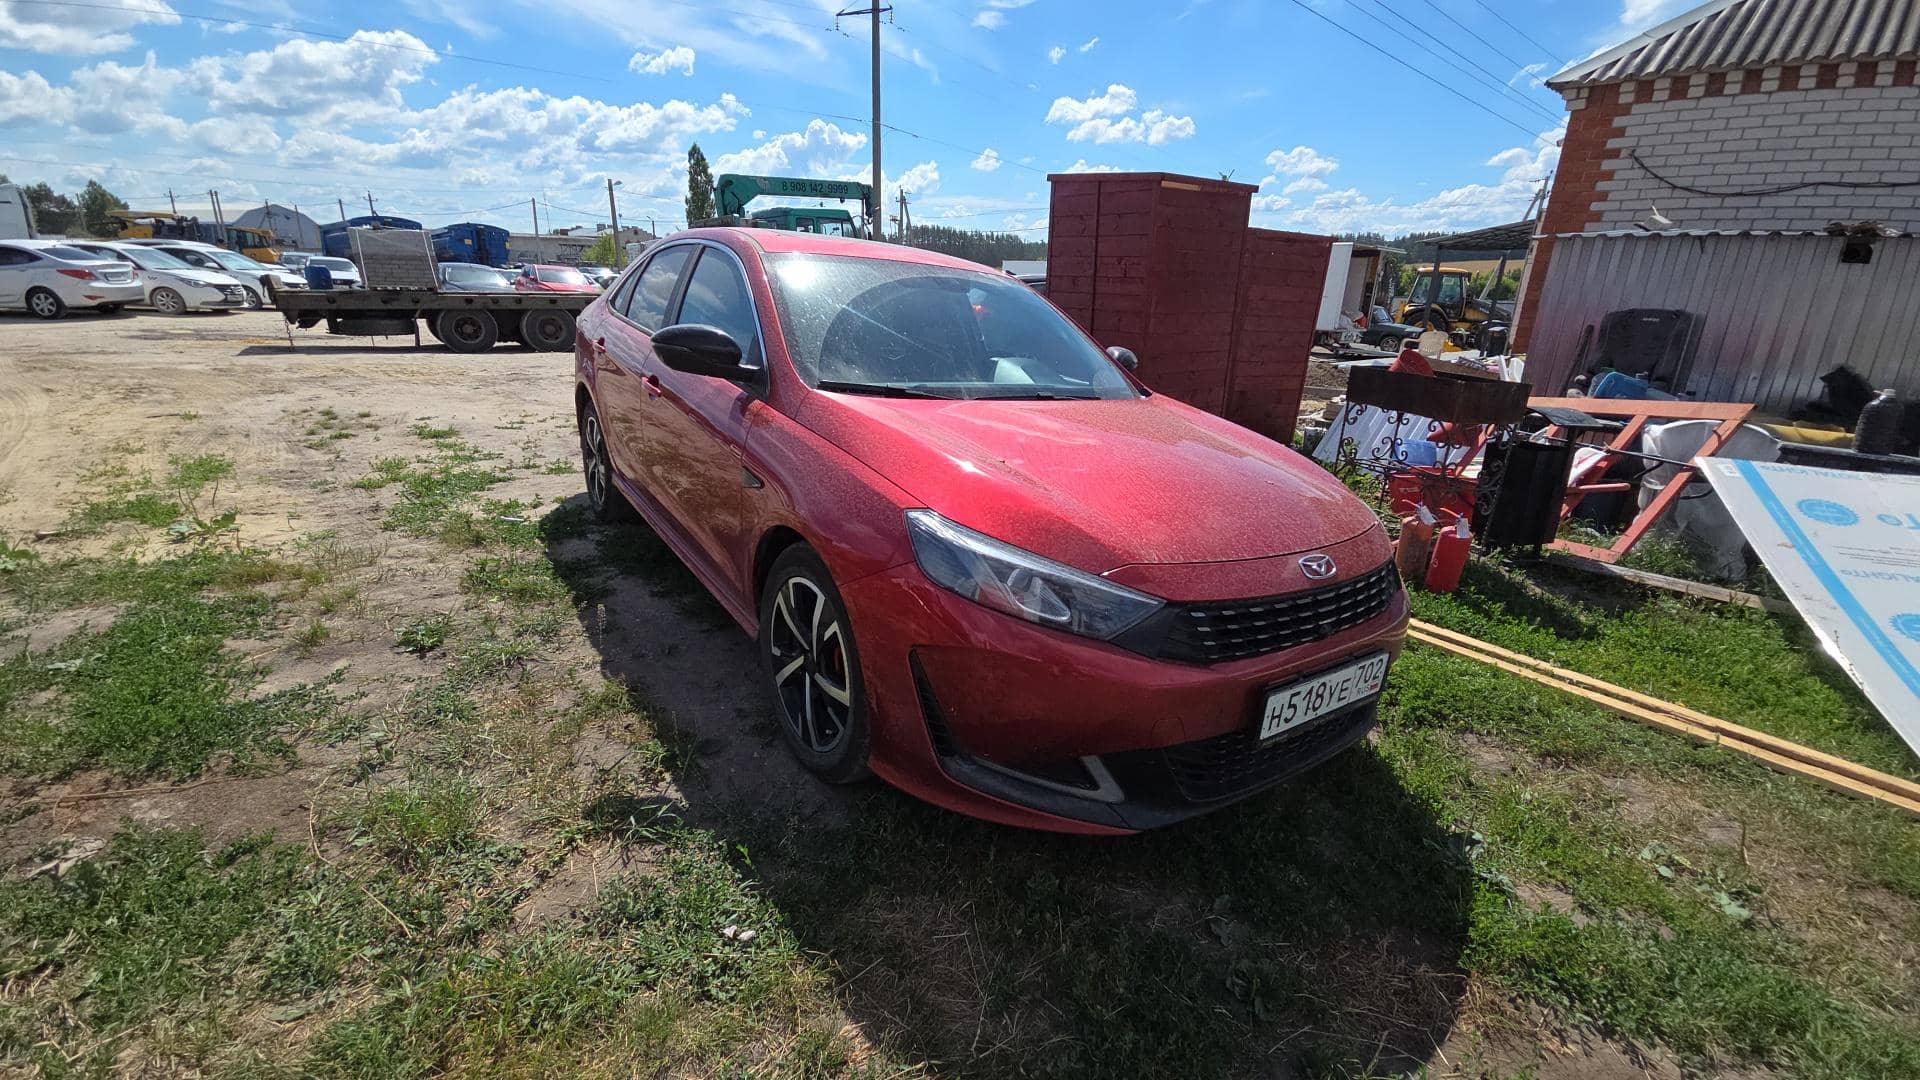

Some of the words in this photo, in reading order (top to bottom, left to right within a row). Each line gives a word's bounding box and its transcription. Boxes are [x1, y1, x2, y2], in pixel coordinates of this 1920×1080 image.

[782, 181, 788, 192] 8
[790, 181, 807, 192] 908
[810, 183, 823, 193] 142
[828, 184, 848, 194] 9999
[1268, 679, 1350, 731] Н518УЕ
[1355, 658, 1384, 688] 702
